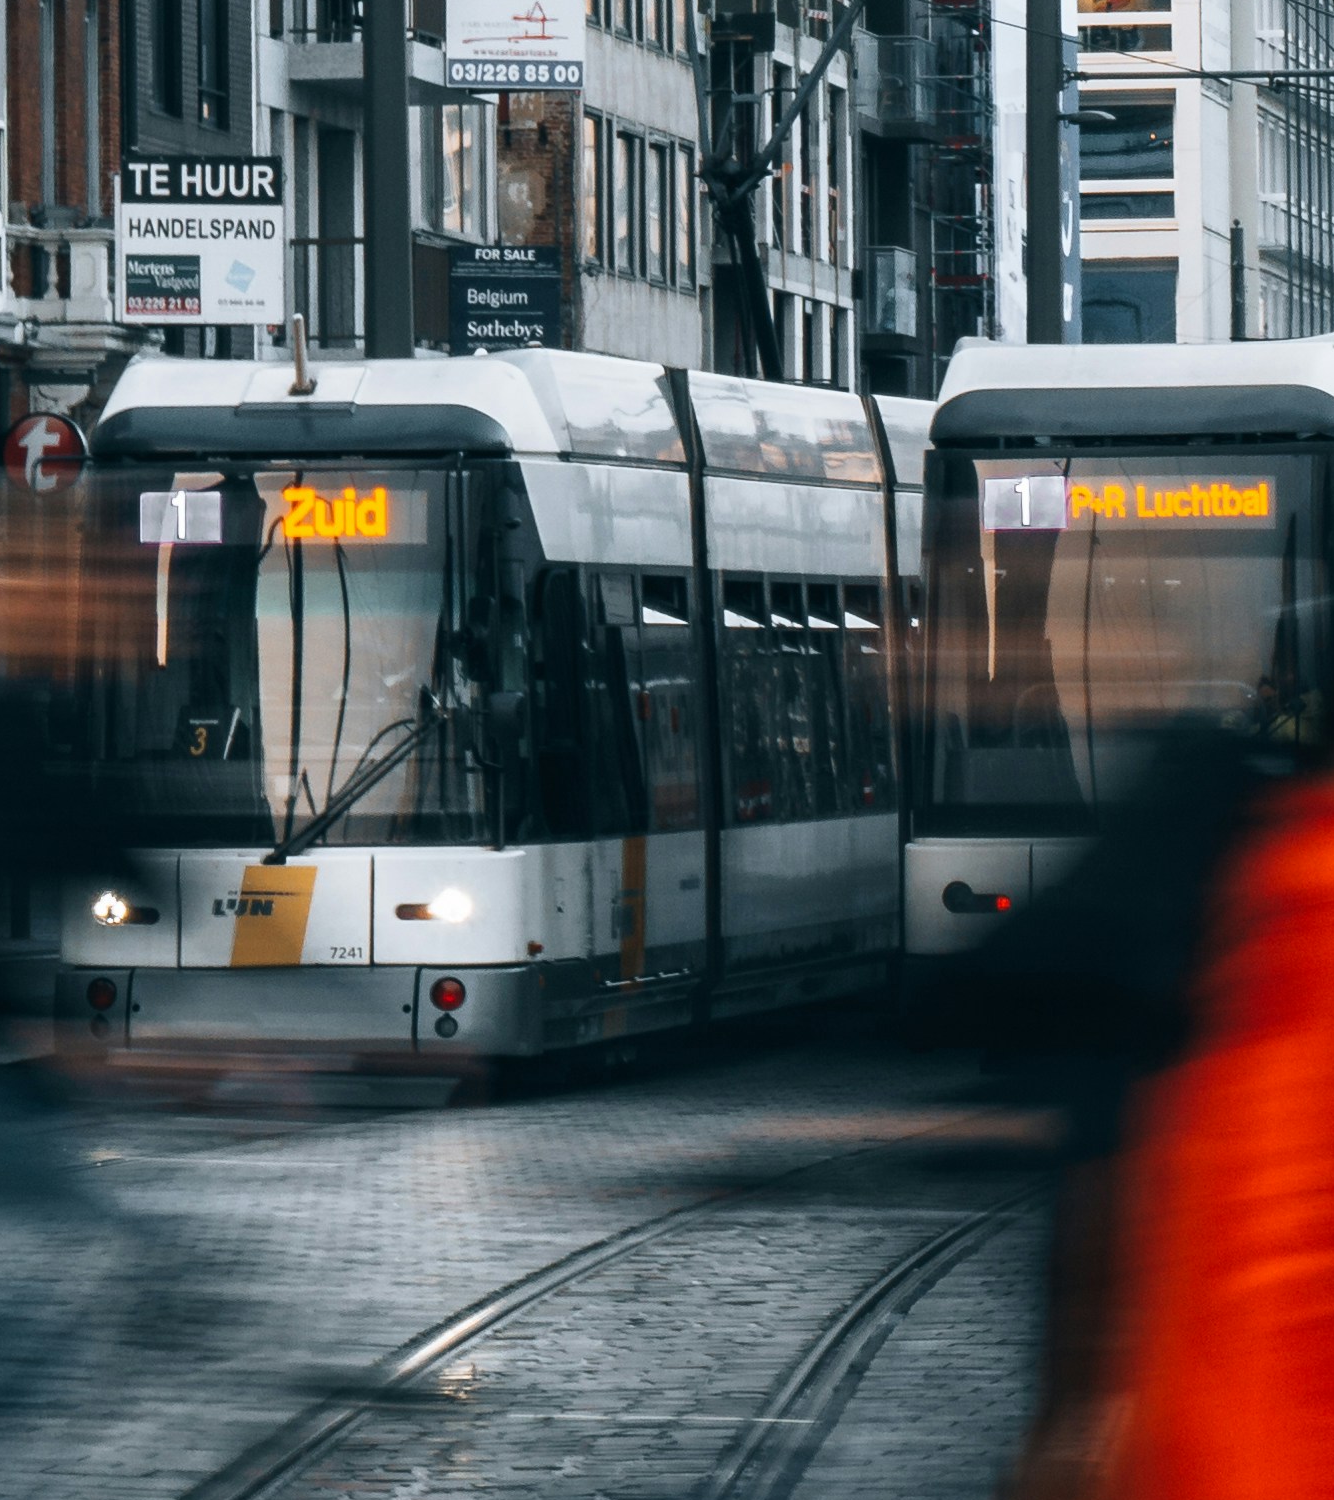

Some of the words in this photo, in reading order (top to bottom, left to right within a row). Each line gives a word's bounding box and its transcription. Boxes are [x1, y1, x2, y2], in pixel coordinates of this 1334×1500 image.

[451, 63, 520, 82] 03/226
[524, 64, 550, 82] 85
[554, 64, 580, 83] 00
[128, 163, 170, 196] TE
[181, 163, 275, 197] HUUR
[128, 217, 276, 239] HANDELSPAND
[475, 248, 501, 260] FOR
[503, 248, 536, 261] SALE
[127, 260, 175, 275] Mertens
[153, 273, 199, 292] Vastgoed
[467, 288, 528, 308] Belgium
[466, 319, 544, 341] Sotheby's
[1014, 476, 1030, 526] 1
[1070, 484, 1126, 518] P+R
[1136, 482, 1268, 518] Luchtbal
[171, 490, 186, 539] 1
[282, 487, 388, 537] Zuid
[330, 947, 363, 959] 7241
